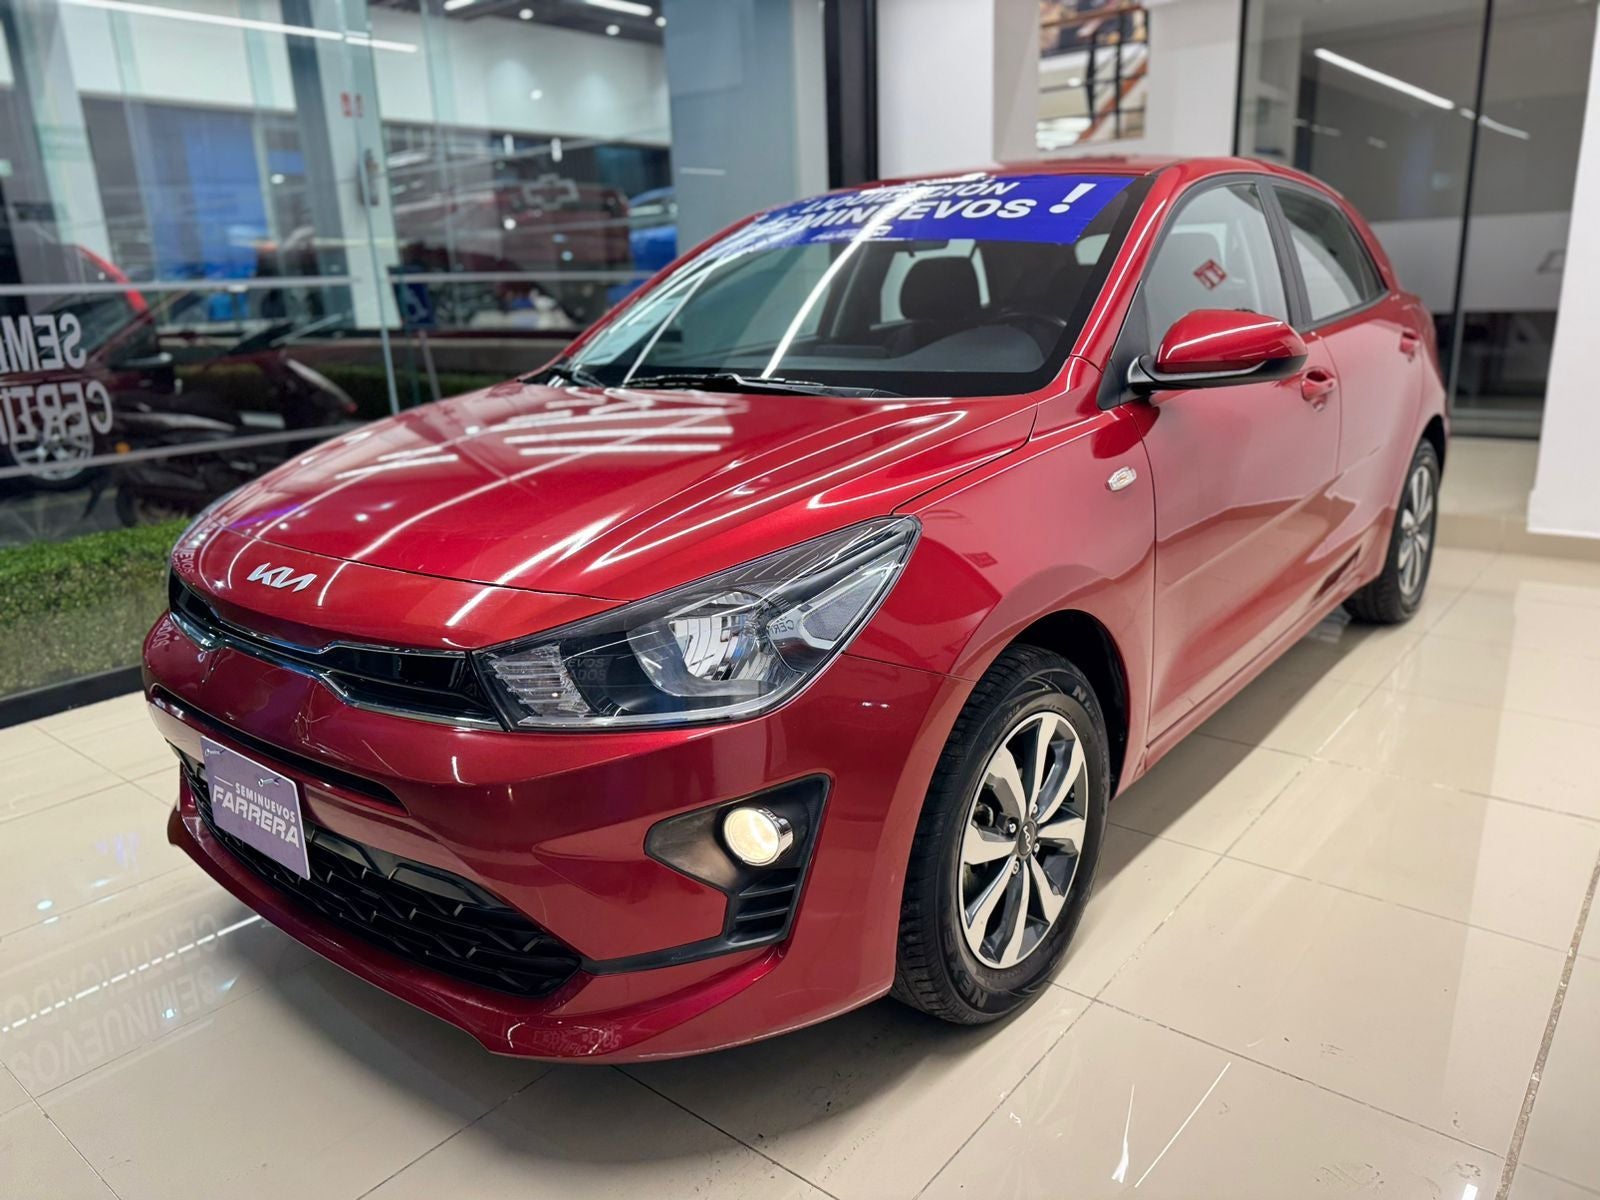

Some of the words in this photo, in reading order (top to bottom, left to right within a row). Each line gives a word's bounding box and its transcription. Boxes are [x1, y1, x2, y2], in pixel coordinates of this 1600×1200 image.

[766, 198, 1037, 232] EMINEVOS
[246, 562, 318, 593] KIA
[213, 784, 300, 849] FARRERA
[235, 782, 296, 824] SEMINUEVOS
